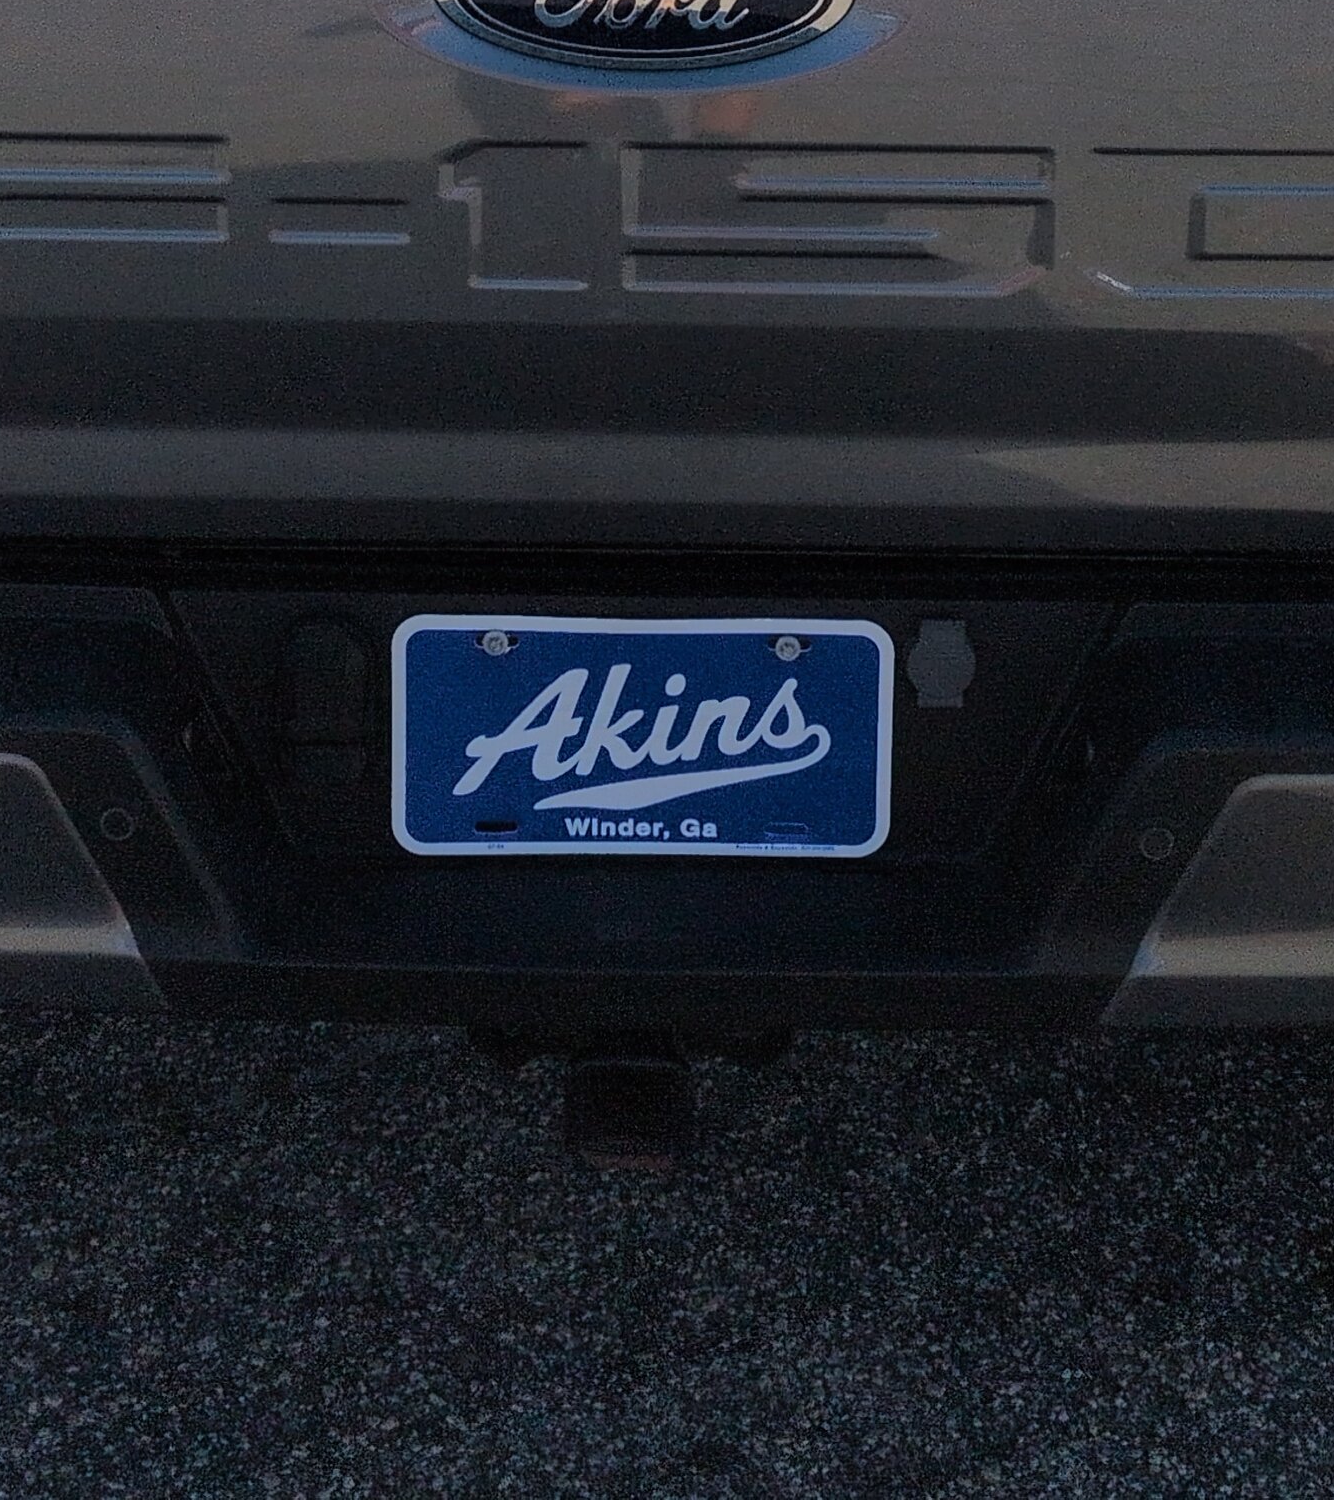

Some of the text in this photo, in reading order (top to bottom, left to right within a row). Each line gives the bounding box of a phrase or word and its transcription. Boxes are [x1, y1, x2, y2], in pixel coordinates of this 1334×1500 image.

[453, 663, 831, 811] Akins
[563, 817, 718, 840] Winder, Ga
